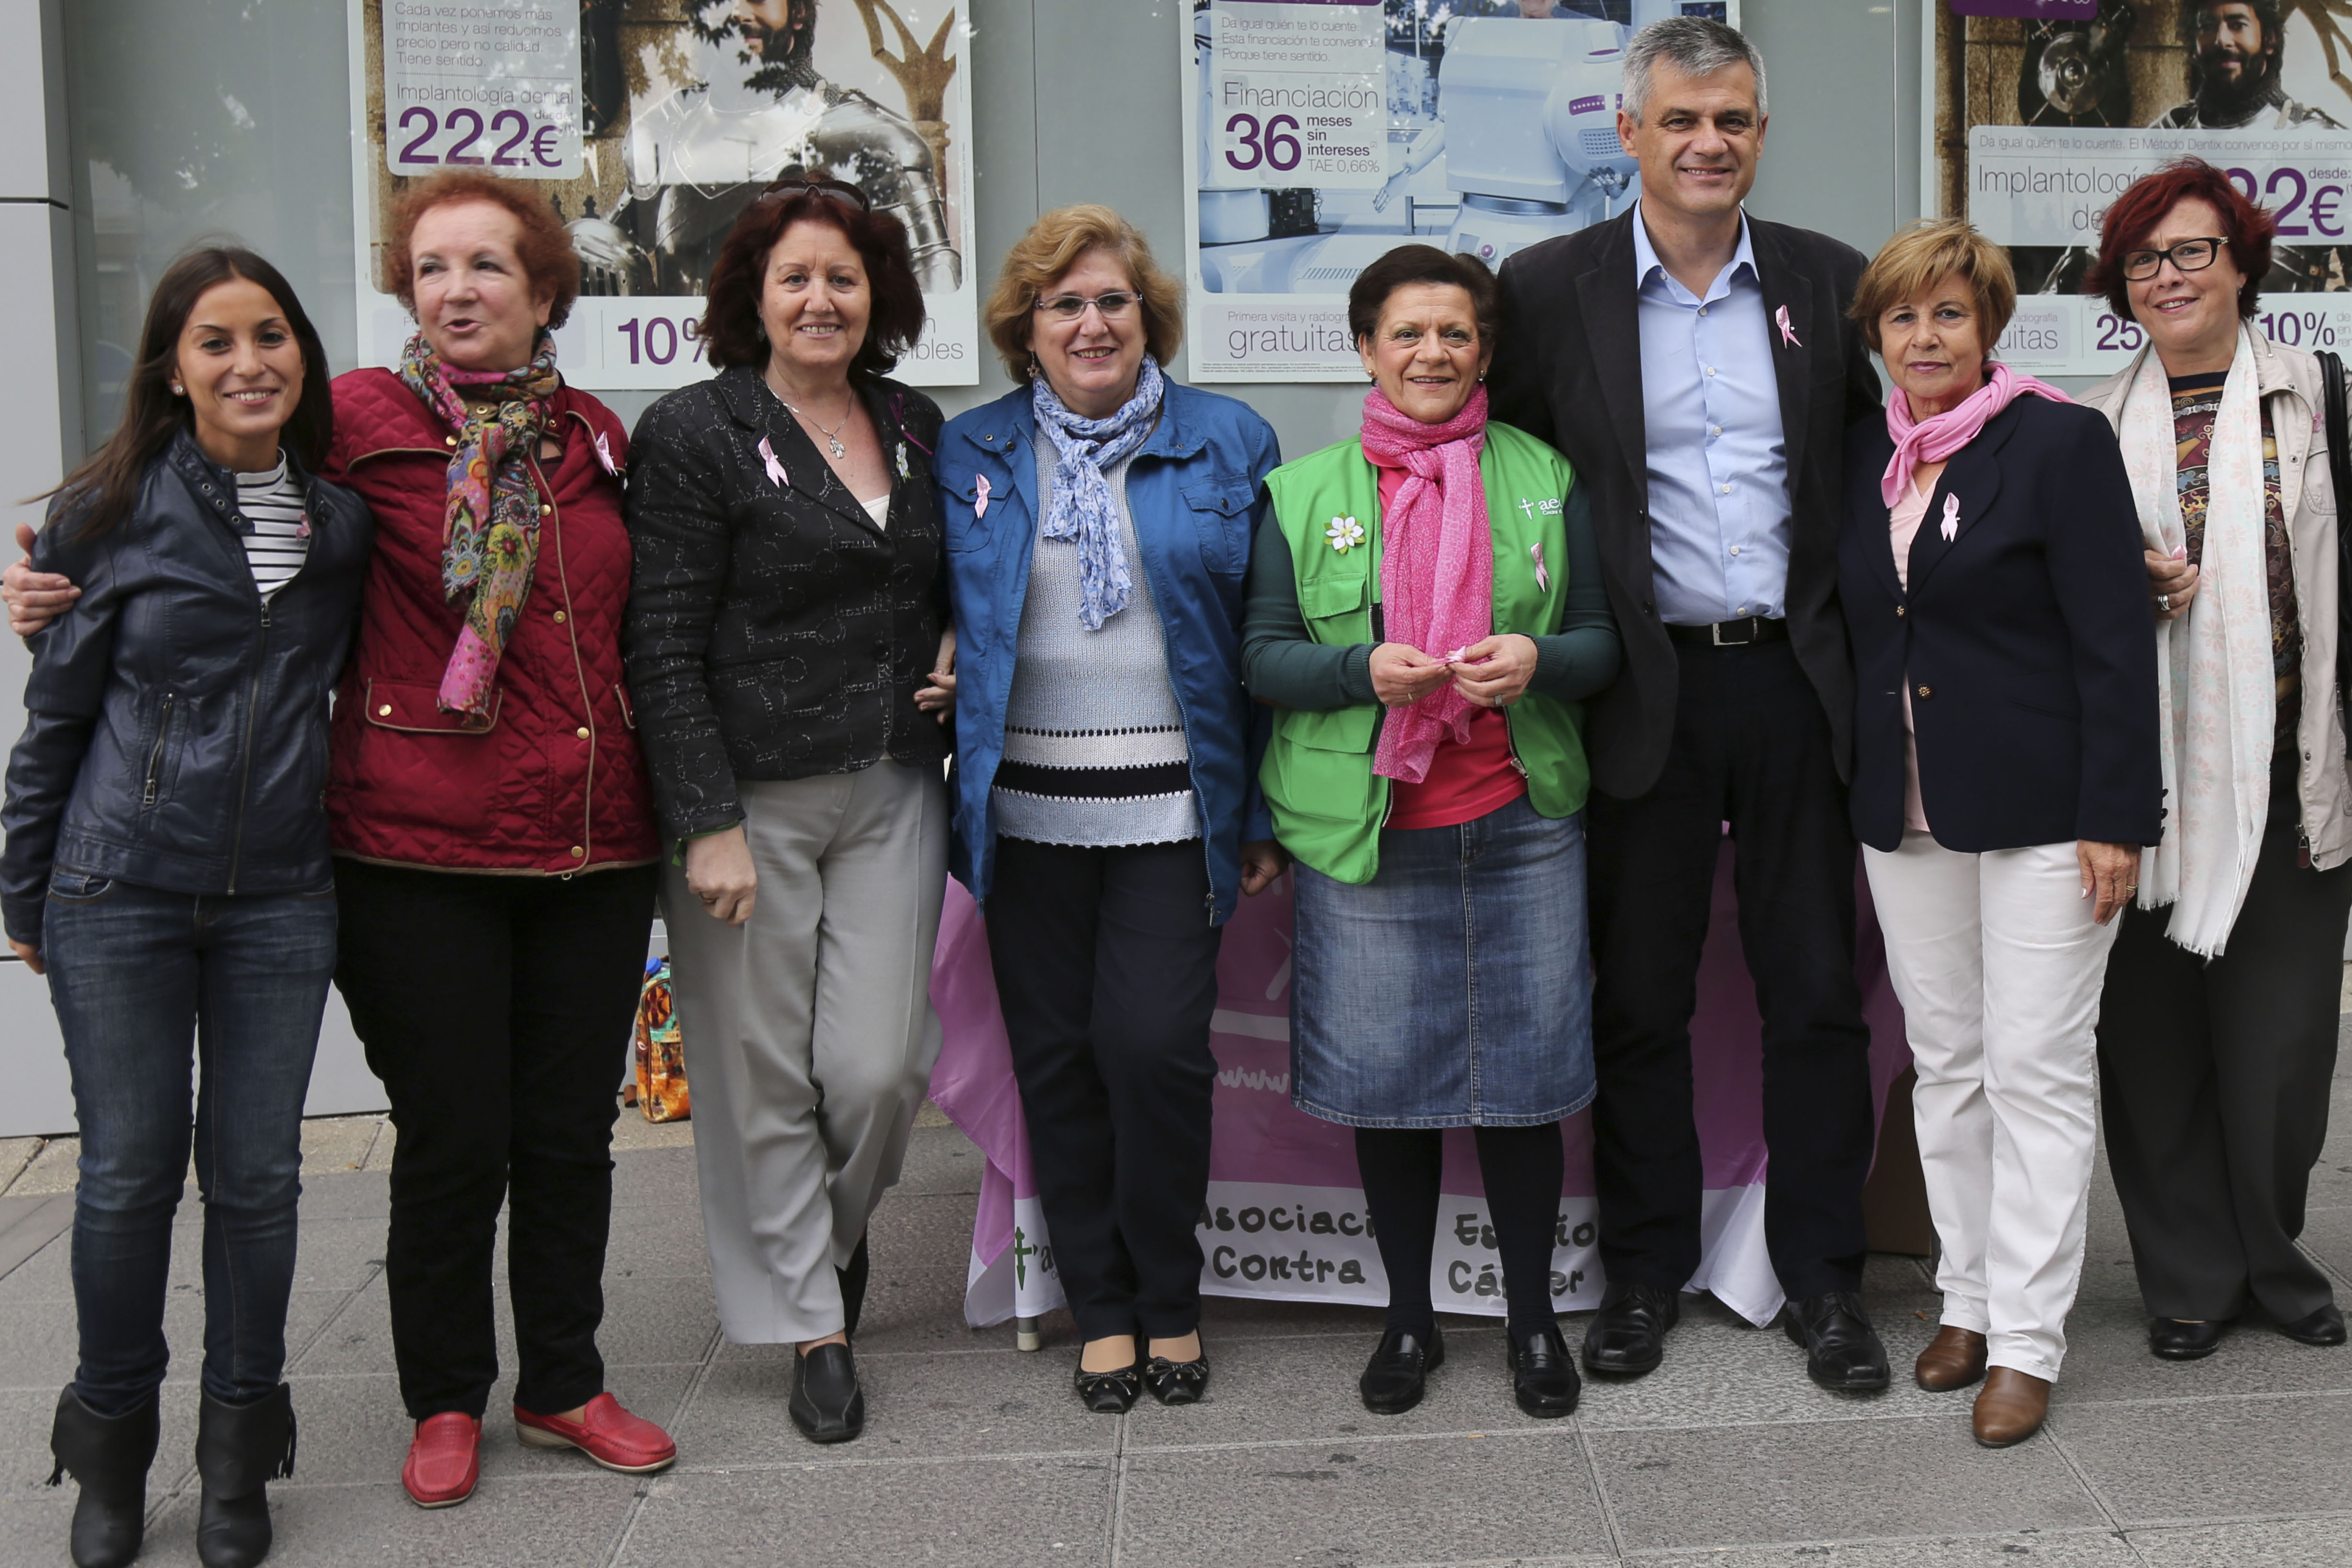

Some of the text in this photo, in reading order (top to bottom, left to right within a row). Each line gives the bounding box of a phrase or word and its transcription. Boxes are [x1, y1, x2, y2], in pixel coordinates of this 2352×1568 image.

[395, 2, 552, 20] Cada vez ponemos más
[396, 19, 561, 37] implantes y así reducimos
[1222, 17, 1360, 31] Da igual quién te lo cuente.
[396, 36, 543, 53] precio pero no calidad.
[1222, 32, 1376, 47] Esta financiación te convence.
[396, 51, 486, 67] Tiene sentido.
[1223, 48, 1330, 62] Porque tiene sentido.
[397, 83, 573, 106] Implantología dental
[1224, 82, 1379, 109] Financiación
[1307, 116, 1352, 127] meses
[399, 107, 563, 167] 222€
[1225, 113, 1301, 171] 36
[1307, 129, 1327, 141] sin
[1307, 144, 1370, 156] intereses
[1980, 135, 1995, 147] Da
[1998, 136, 2023, 150] igual
[2026, 137, 2056, 150] quién
[2059, 138, 2069, 149] te
[2073, 138, 2082, 149] lo
[2085, 139, 2125, 149] cuente.
[2129, 137, 2139, 149] El
[2143, 138, 2184, 150] Método
[2188, 138, 2222, 150] Dentix
[2225, 140, 2279, 150] convence
[2283, 141, 2301, 152] por
[1308, 159, 1380, 174] TAE 0,66%
[2308, 167, 2351, 179] desde:
[1228, 311, 1267, 322] Primera
[1270, 312, 1297, 322] visita
[1300, 314, 1306, 324] y
[2259, 311, 2335, 346] 10%
[1212, 1245, 1366, 1285] Contra
